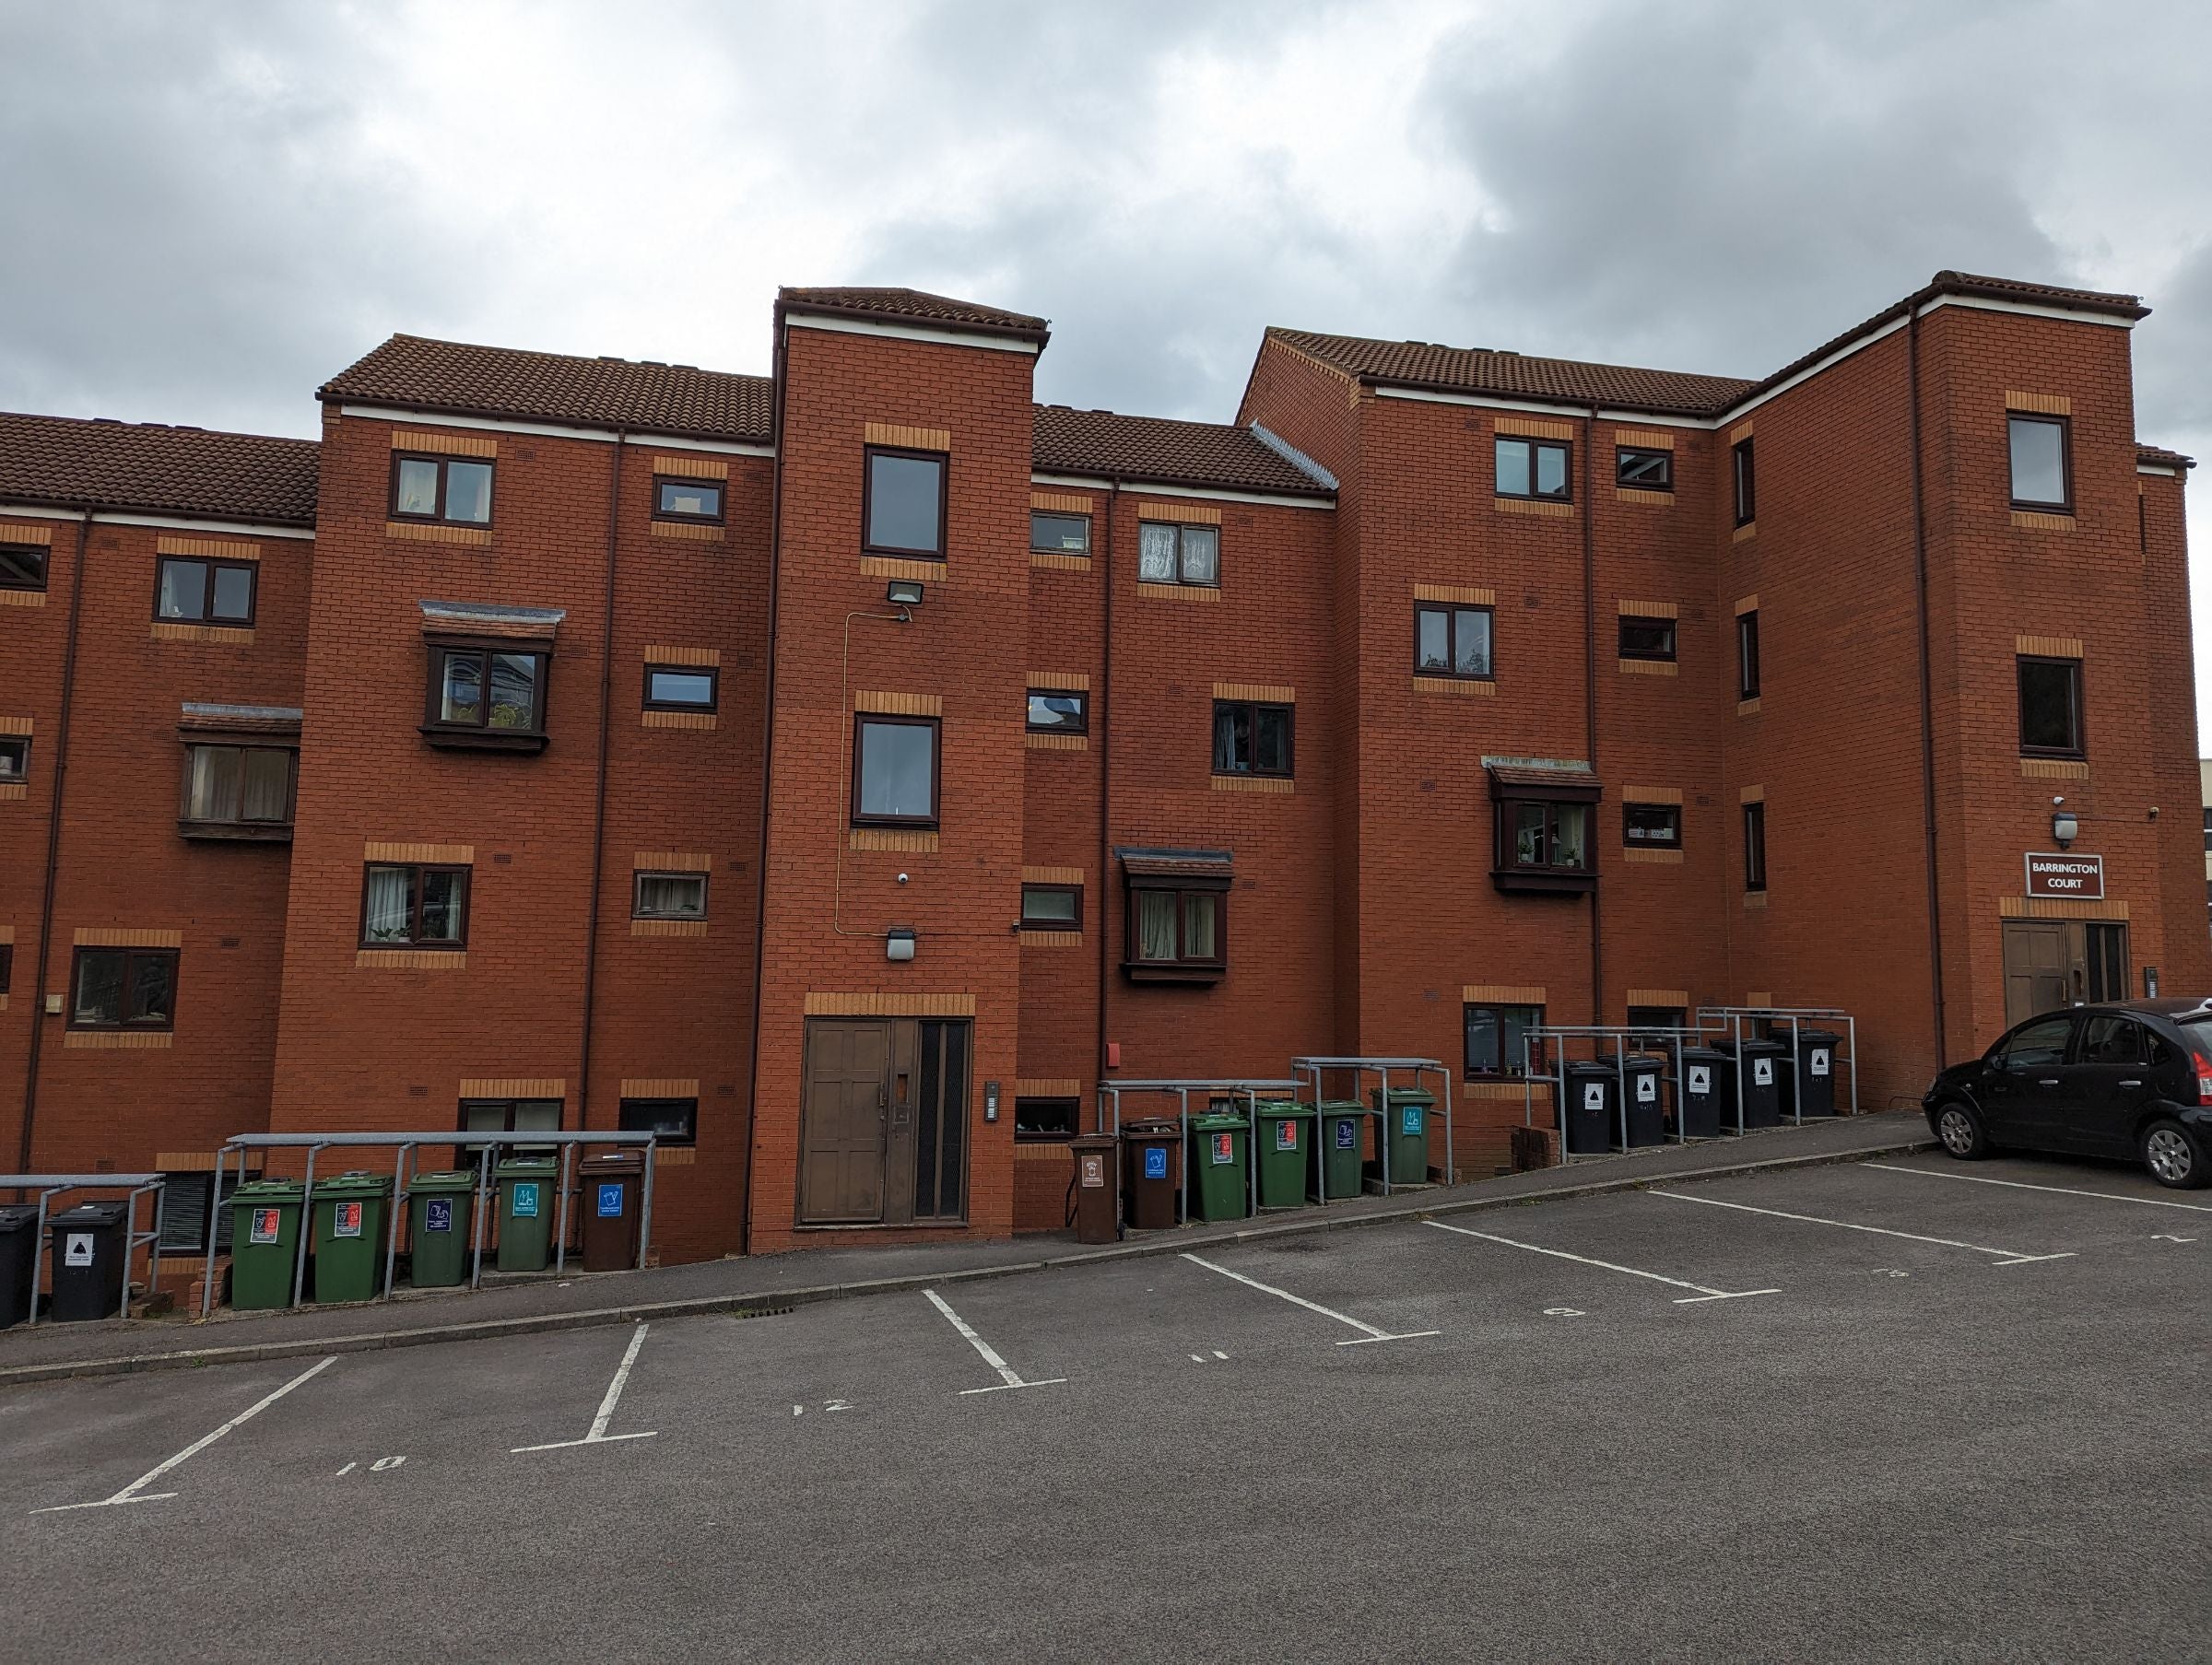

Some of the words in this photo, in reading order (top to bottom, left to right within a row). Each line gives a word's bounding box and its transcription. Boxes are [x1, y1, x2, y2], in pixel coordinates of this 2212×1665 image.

[2032, 862, 2097, 874] BARRINGTON
[2048, 878, 2083, 888] COURT
[794, 1399, 853, 1416] 12
[335, 1455, 408, 1476] 10
